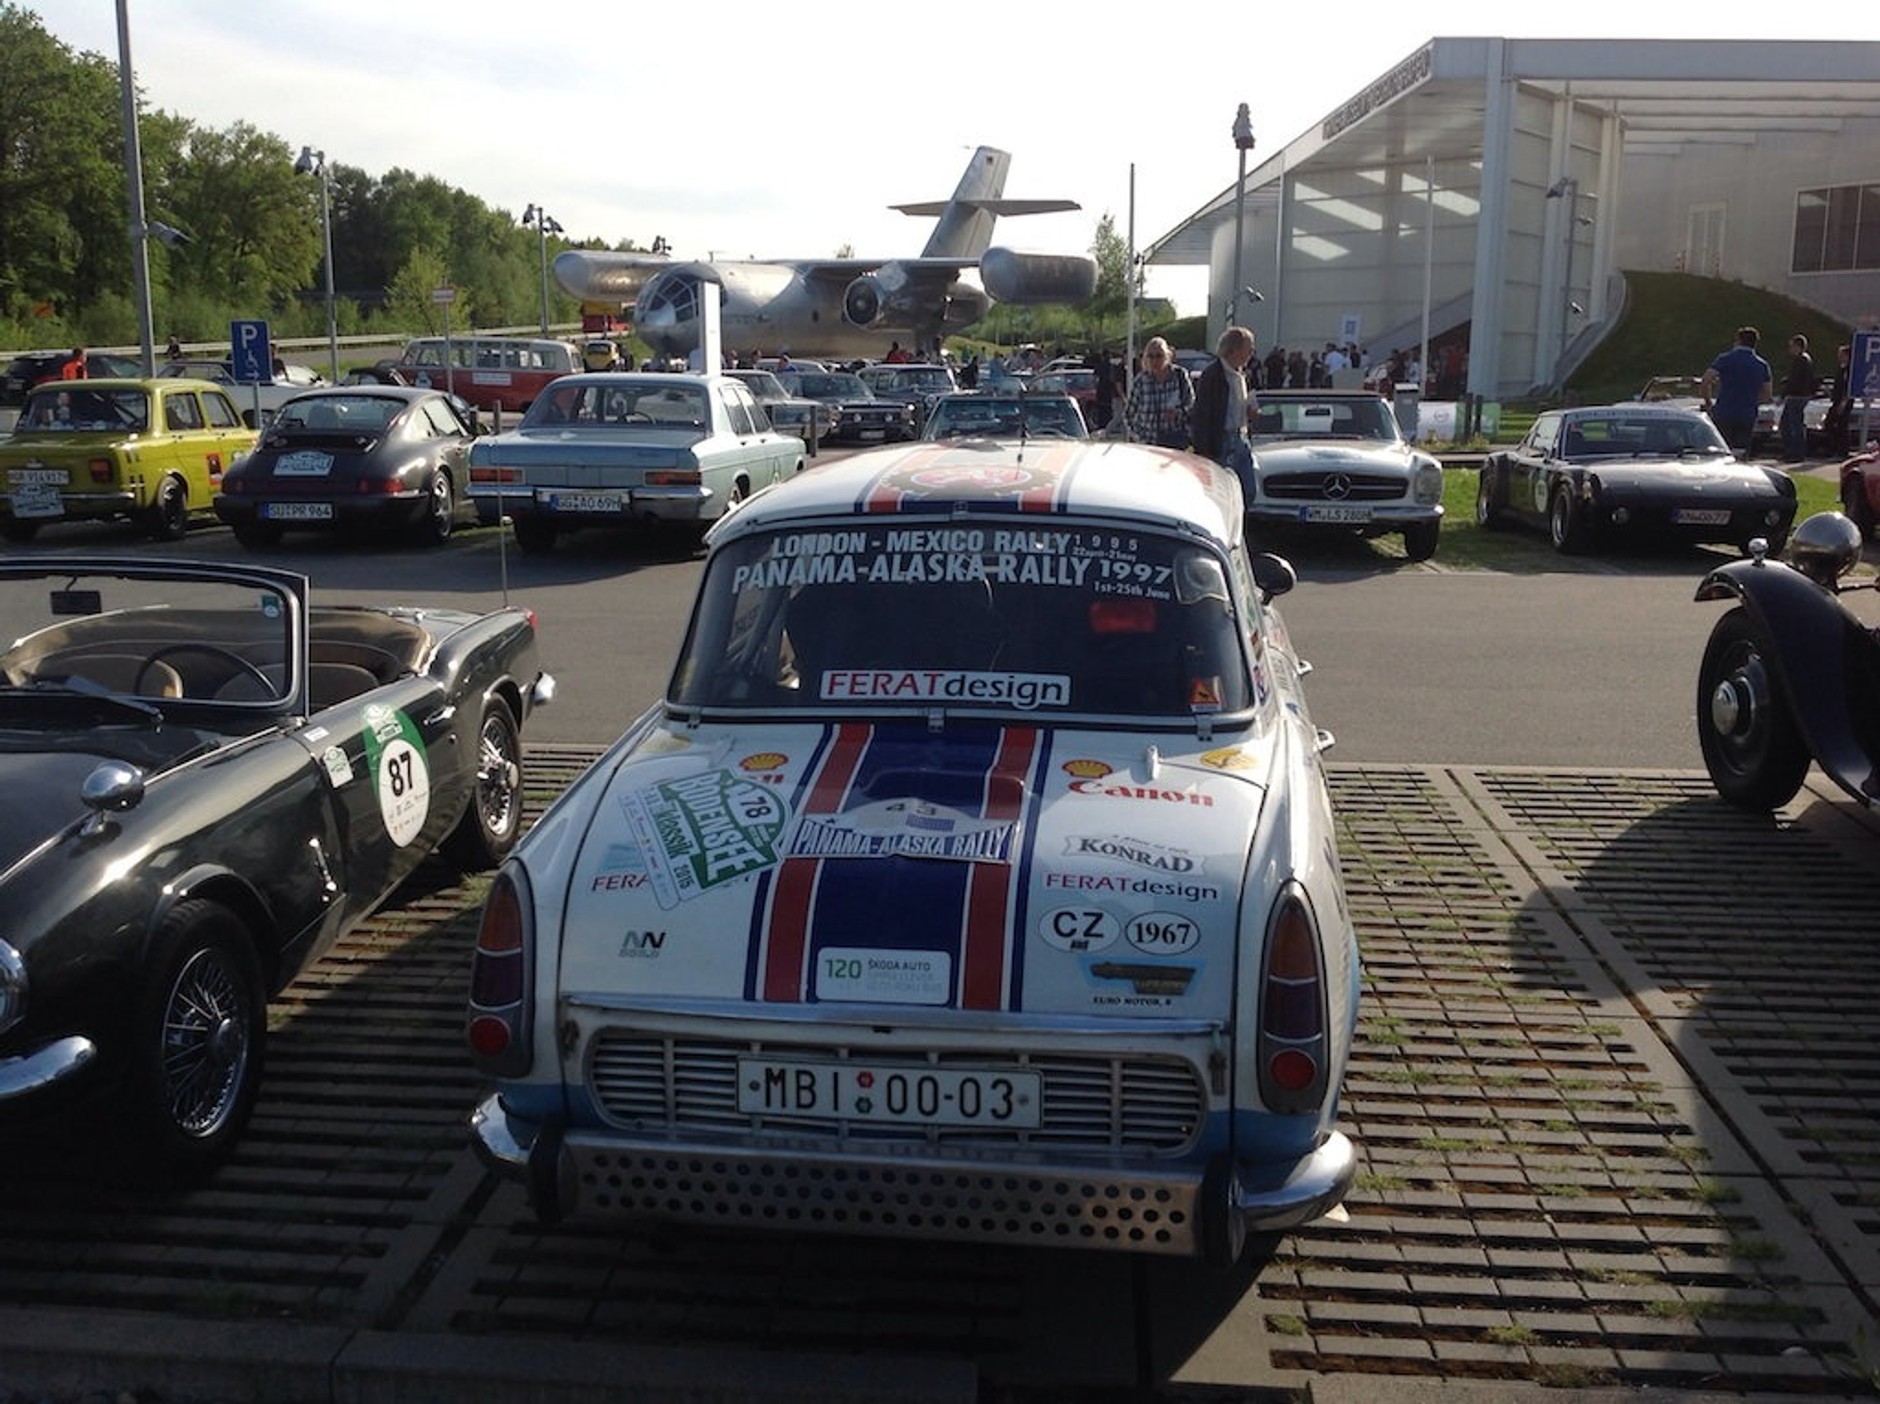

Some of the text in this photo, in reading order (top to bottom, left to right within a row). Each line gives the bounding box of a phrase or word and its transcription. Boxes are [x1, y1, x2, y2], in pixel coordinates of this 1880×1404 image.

[241, 325, 258, 349] P
[772, 532, 867, 558] LONDON
[887, 530, 985, 552] MEXICO
[994, 531, 1071, 554] RALLY
[1101, 559, 1172, 585] 1997
[827, 673, 1063, 707] FERATdesign
[388, 751, 413, 797] 87
[1068, 779, 1214, 807] Canon
[668, 772, 768, 881] BODENSEE
[794, 820, 946, 855] PANAMA-ALASKA
[951, 822, 1010, 858] RALLY
[1079, 838, 1193, 873] KONRAD
[1046, 873, 1218, 902] FERATdesign
[1053, 911, 1104, 938] CZ
[1135, 923, 1191, 945] 1967
[825, 960, 862, 979] 120
[902, 961, 931, 972] AUTO
[764, 1068, 1013, 1119] MBI 00-03
